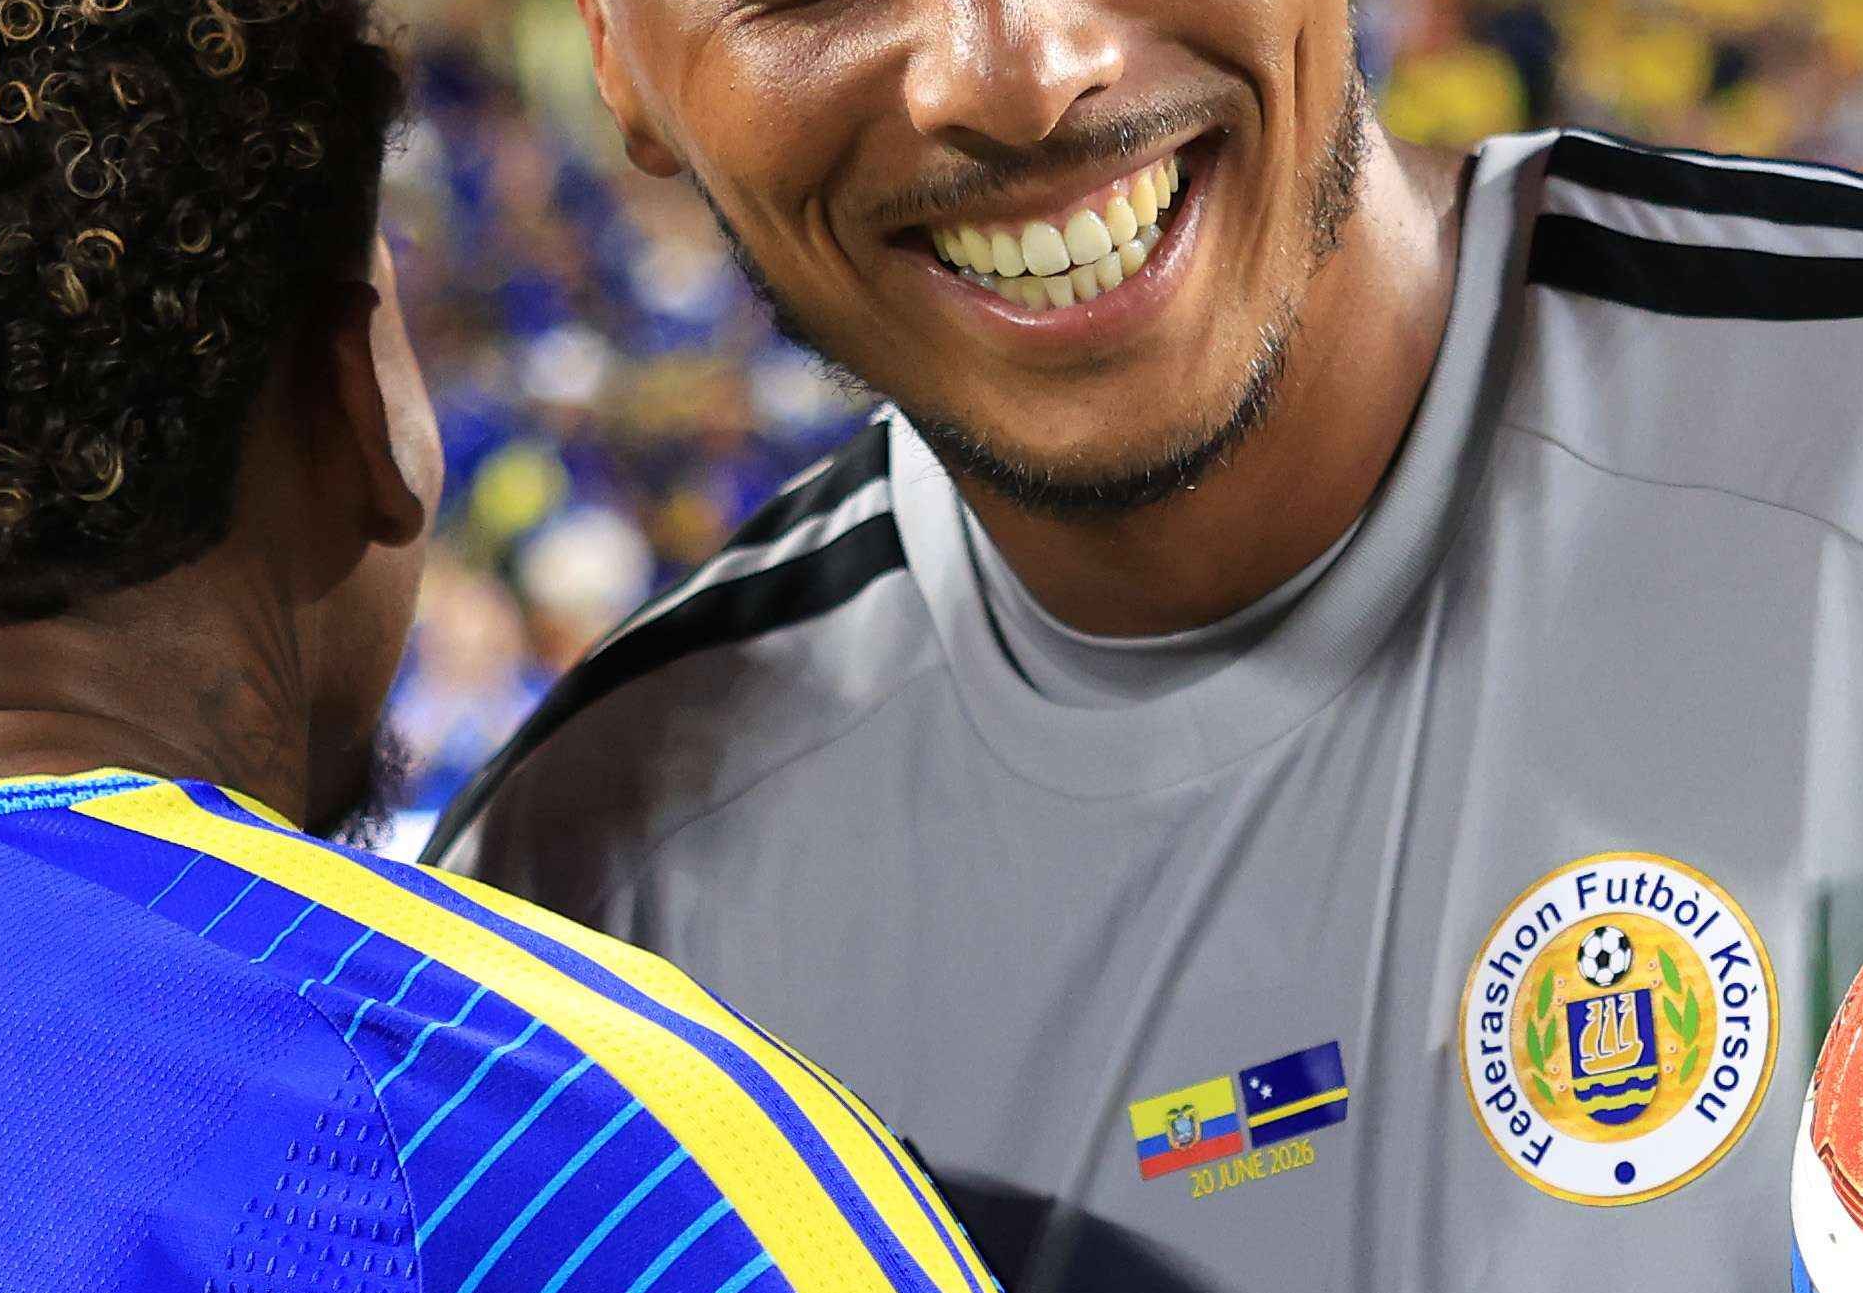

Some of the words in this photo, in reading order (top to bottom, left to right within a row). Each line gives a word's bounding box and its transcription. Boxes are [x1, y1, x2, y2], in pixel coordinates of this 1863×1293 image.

[1480, 900, 1563, 1167] Federashon
[1190, 1168, 1216, 1199] 20
[1219, 1149, 1267, 1192] JUNE
[1267, 1138, 1315, 1175] 2026
